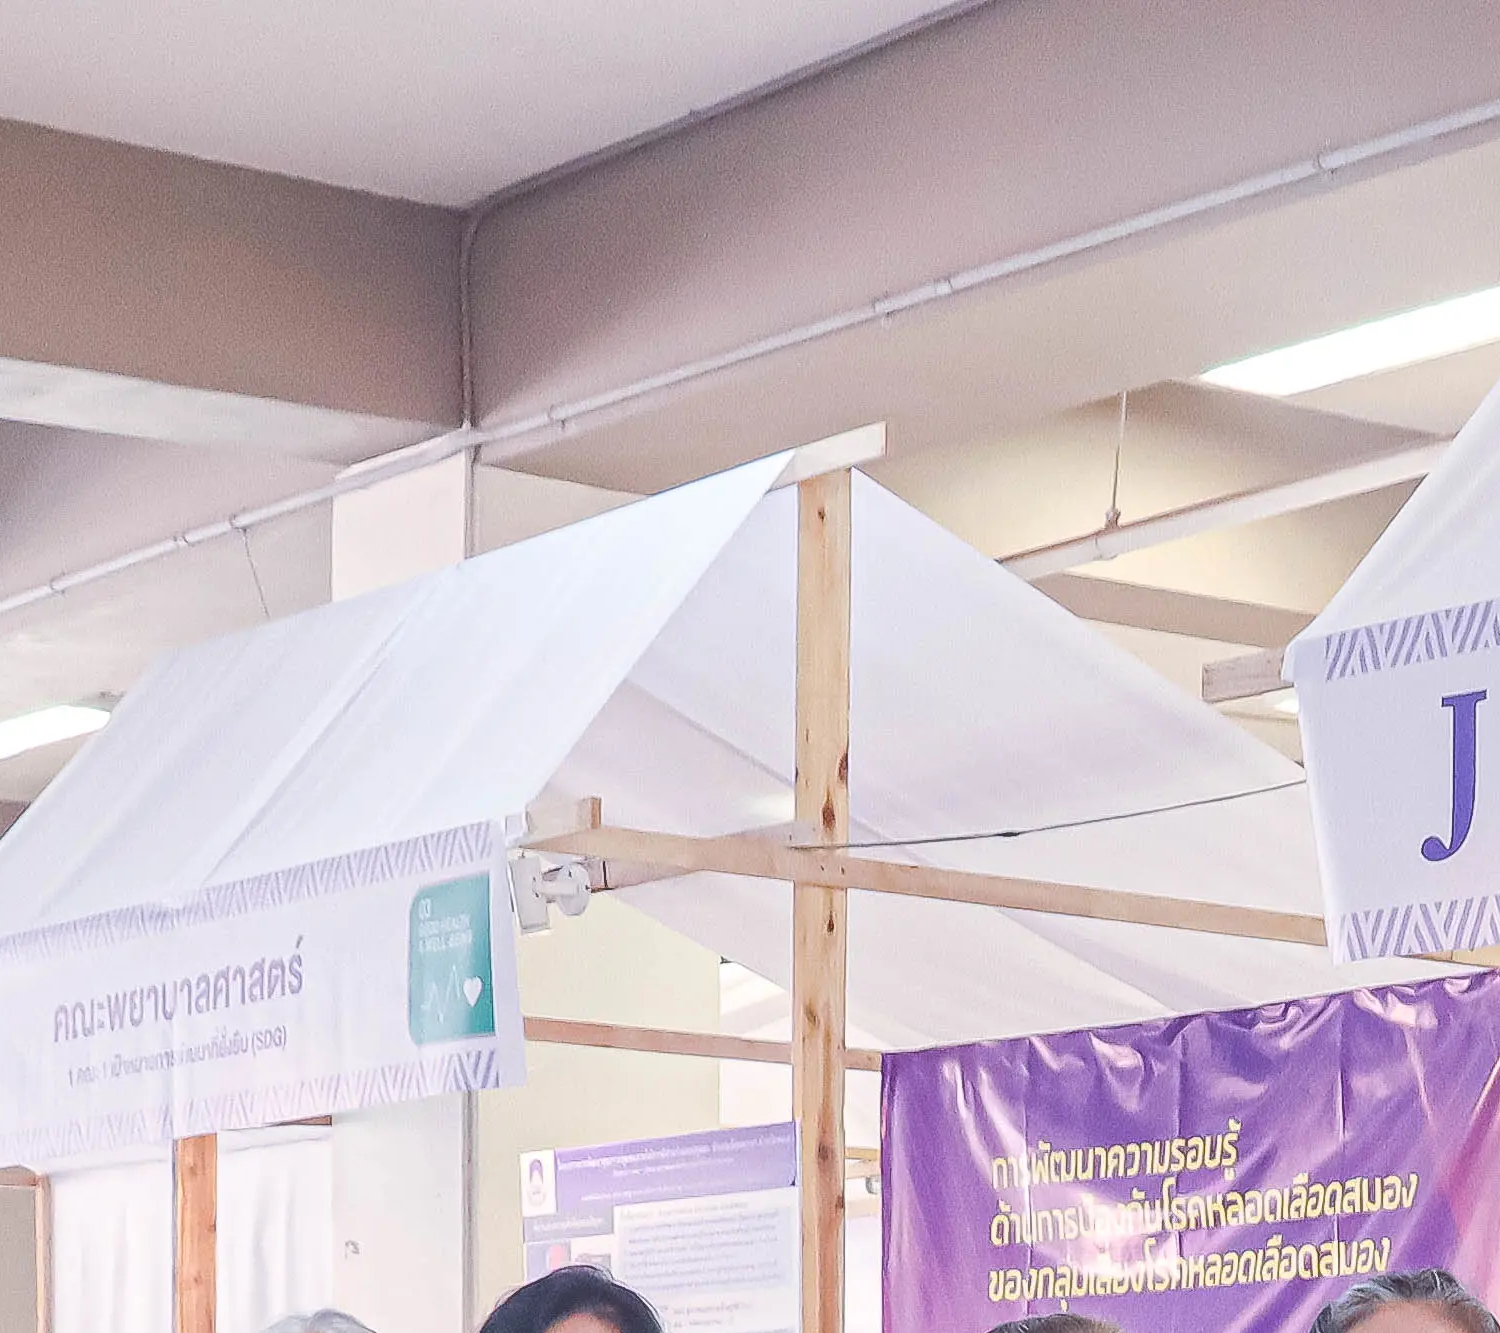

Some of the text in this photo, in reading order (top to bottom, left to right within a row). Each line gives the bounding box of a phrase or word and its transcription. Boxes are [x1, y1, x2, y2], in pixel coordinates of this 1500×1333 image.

[1420, 688, 1489, 863] J
[52, 934, 304, 1043] คณะพยาบาลศาสตร์
[991, 1116, 1243, 1190] การพัฒนาความรอบรู้
[989, 1172, 1419, 1247] ด้านการป้องกันโรคหลอดเลือดสมอง
